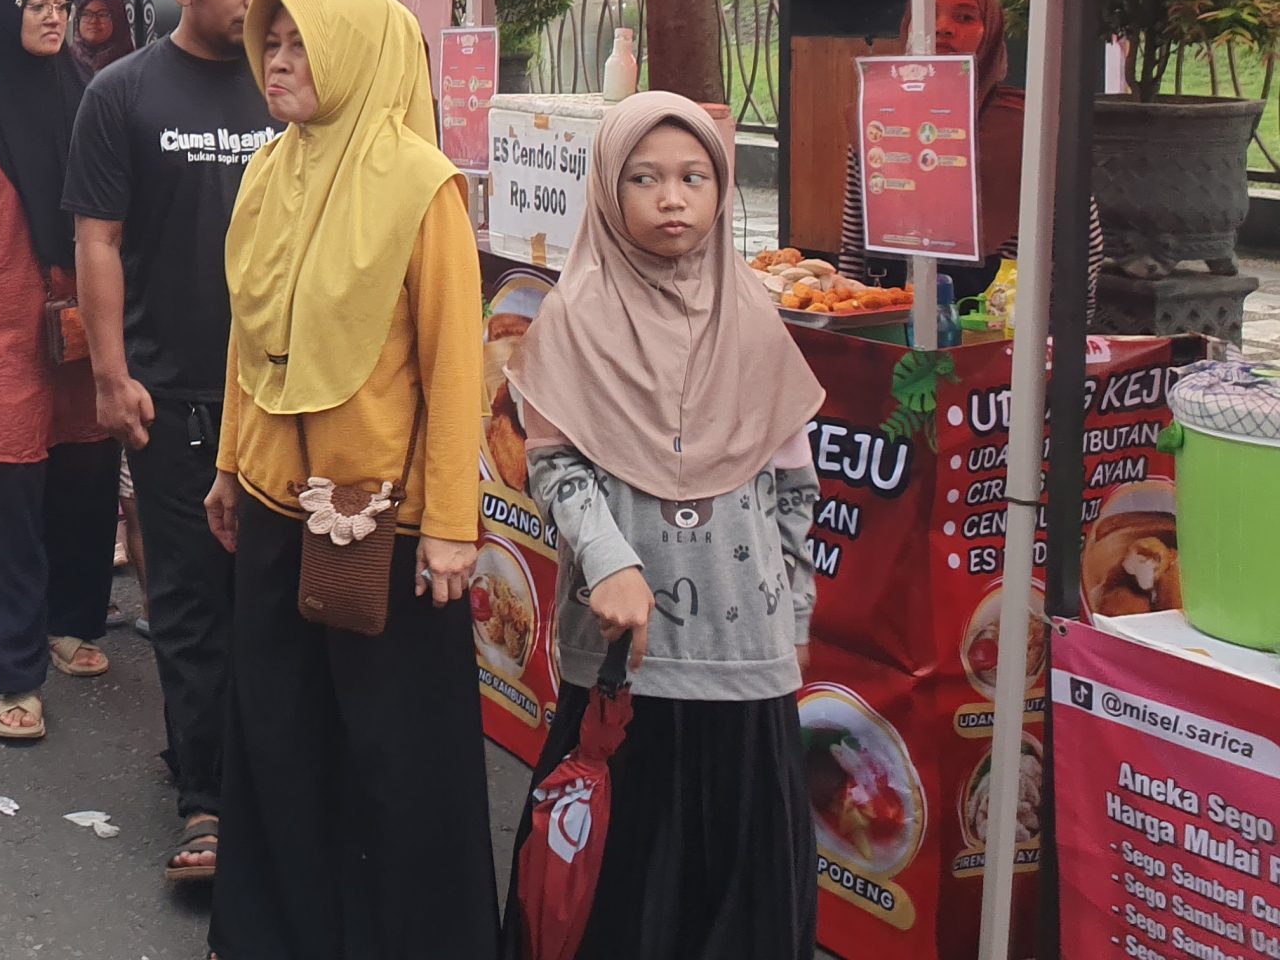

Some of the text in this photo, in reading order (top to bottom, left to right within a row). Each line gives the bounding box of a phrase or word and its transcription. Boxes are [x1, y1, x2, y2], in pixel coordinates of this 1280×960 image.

[160, 127, 216, 152] Cuma
[187, 151, 216, 163] bukan
[493, 136, 586, 181] ES Cendol Suji
[510, 180, 566, 216] Rp. 5000
[1090, 457, 1146, 487] AYAM
[483, 495, 540, 538] UDANG
[662, 530, 714, 544] BEAR
[970, 548, 997, 572] ES
[492, 677, 537, 717] RAMBUTAN
[1101, 692, 1255, 759] @misel.sarica
[1118, 762, 1274, 842] Aneka Sego
[1106, 792, 1175, 844] Harga
[1184, 824, 1260, 876] Mulai
[817, 857, 893, 909] PODENG
[1122, 841, 1166, 878] Sego
[1171, 863, 1245, 911] Sambel
[1251, 895, 1280, 927] Cu
[1124, 872, 1167, 909] Sego
[1171, 895, 1245, 943] Sambel
[1125, 903, 1166, 940] Sego
